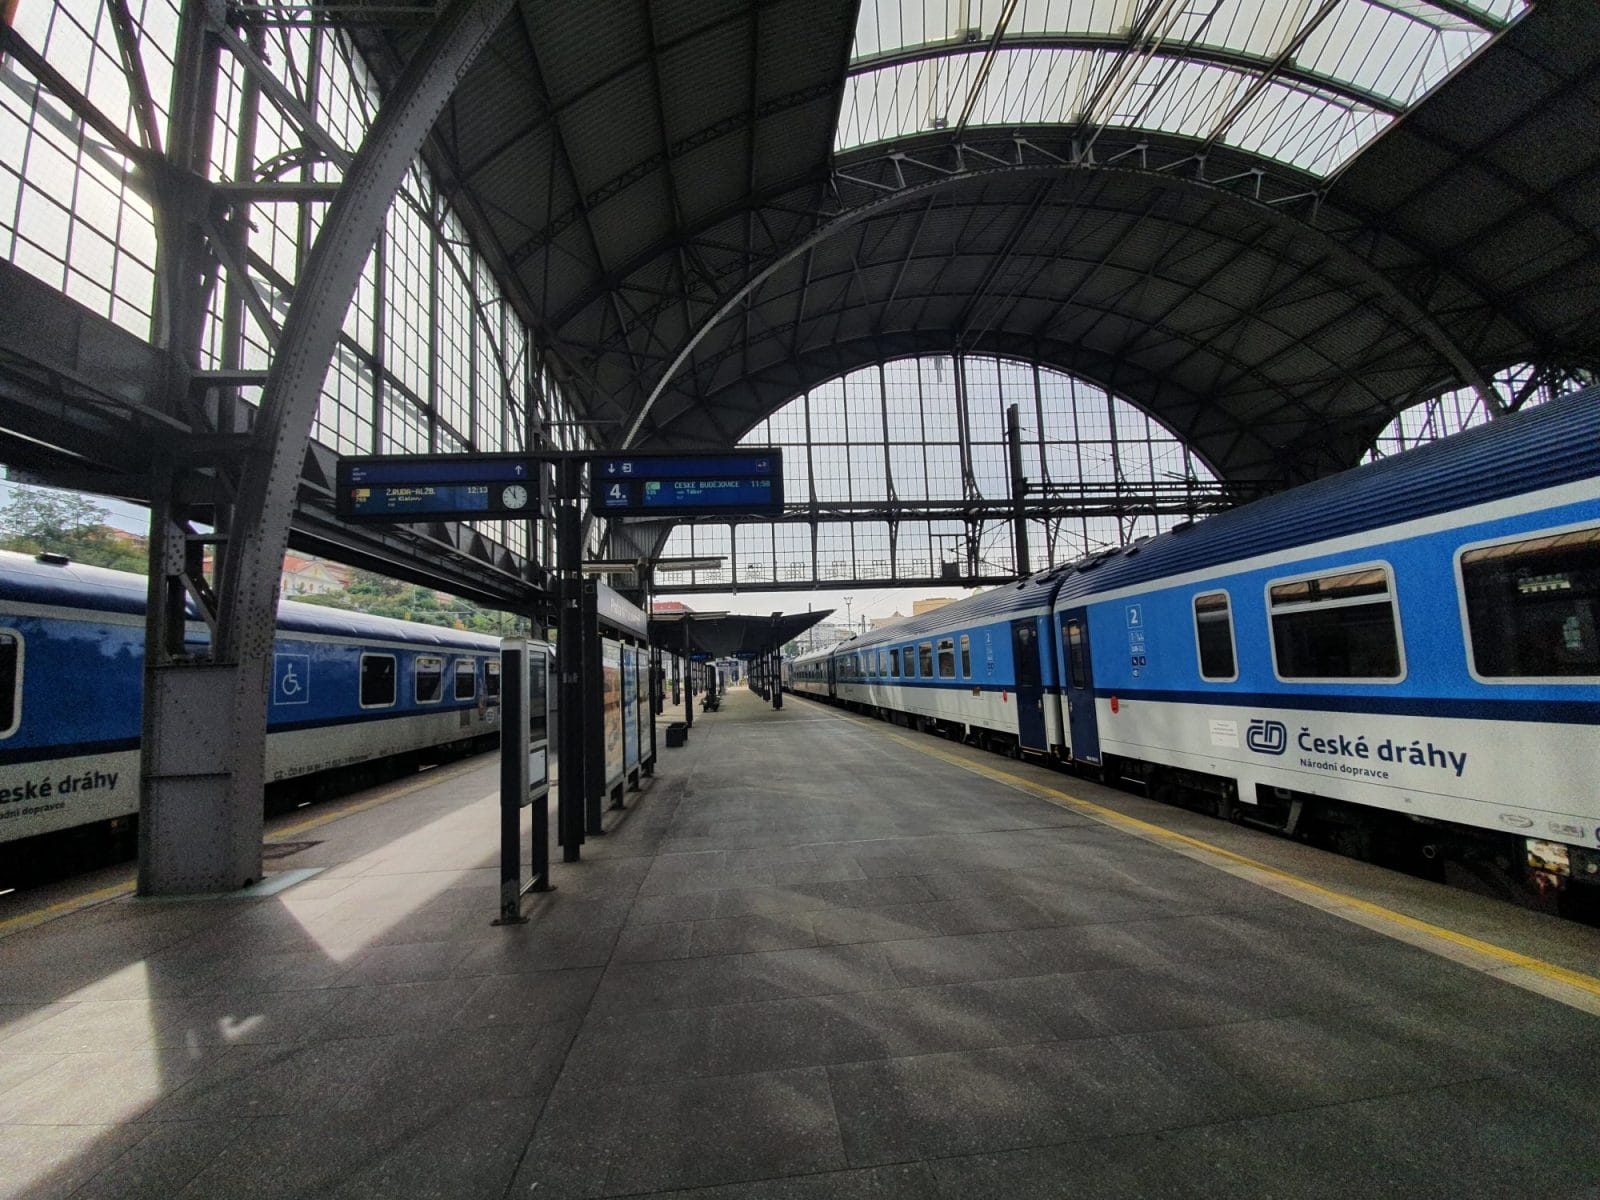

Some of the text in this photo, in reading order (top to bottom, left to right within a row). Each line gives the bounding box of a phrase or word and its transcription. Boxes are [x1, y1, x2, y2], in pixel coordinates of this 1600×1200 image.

[1130, 608, 1138, 624] 2
[1298, 726, 1468, 777] České dráhy
[1300, 758, 1390, 780] Národní dopravce
[58, 770, 119, 795] dráhy
[22, 802, 66, 816] dopravce
